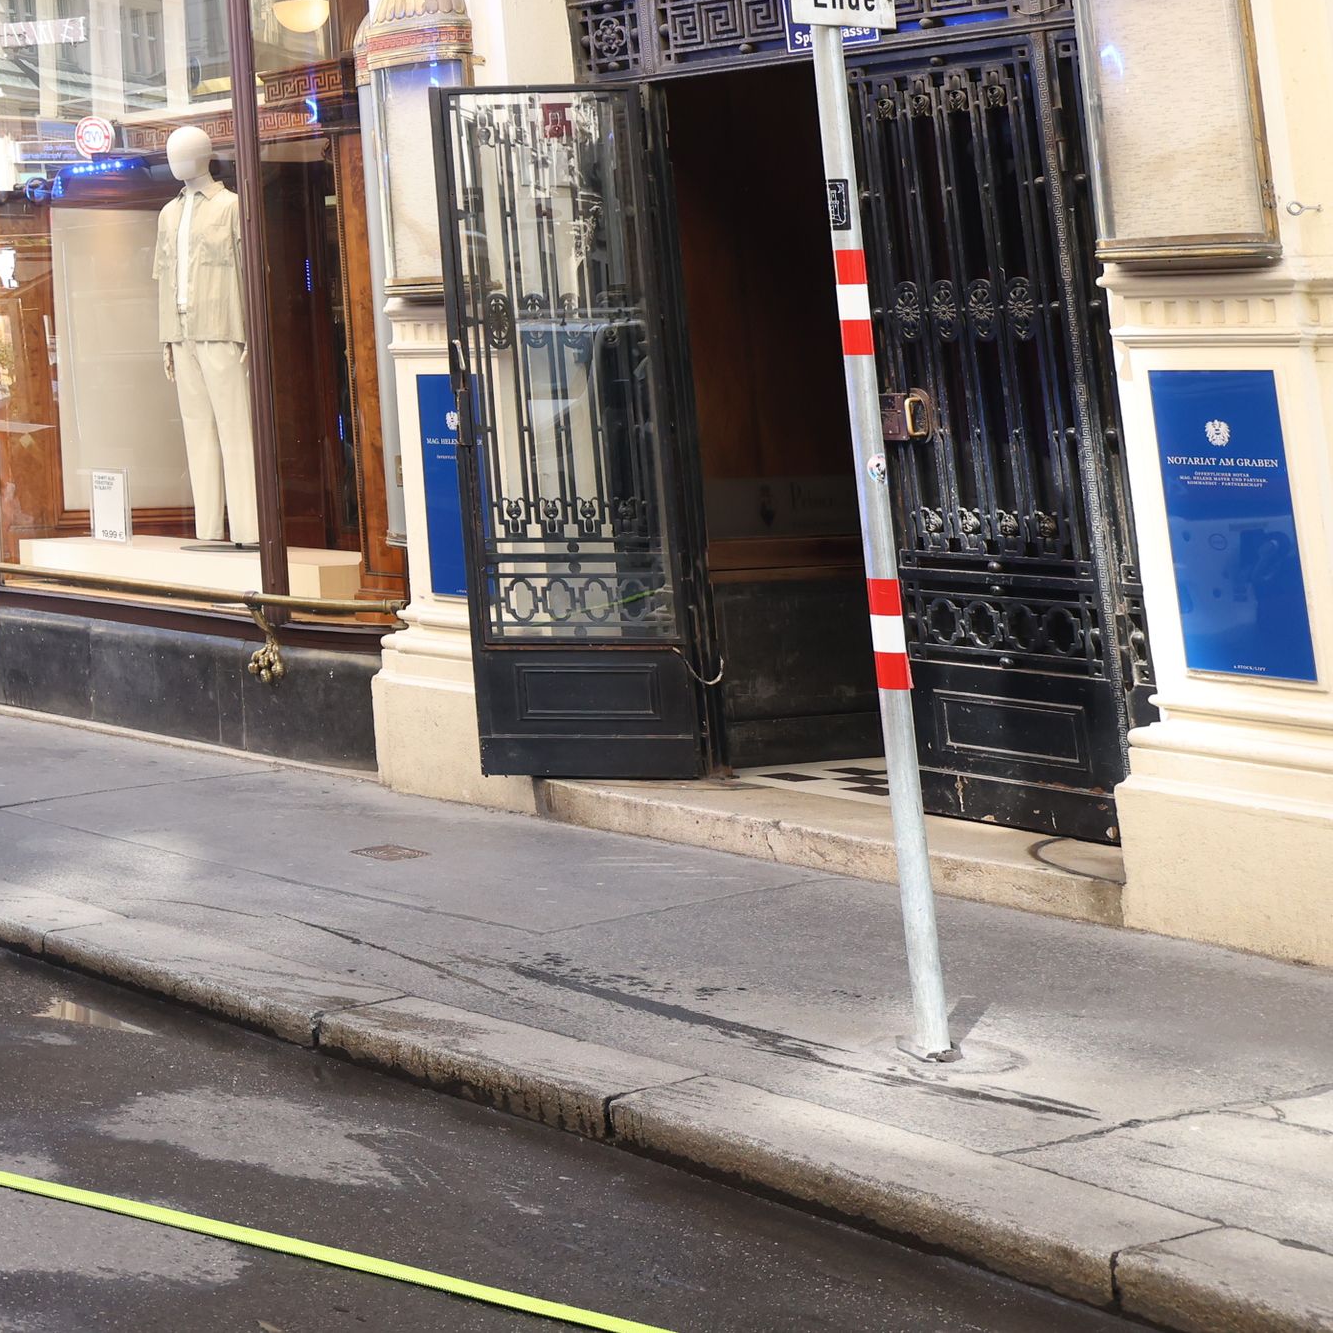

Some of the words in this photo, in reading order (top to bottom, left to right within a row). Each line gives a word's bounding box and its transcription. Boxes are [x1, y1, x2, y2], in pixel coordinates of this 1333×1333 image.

[1166, 456, 1217, 466] NOTARIAT
[1219, 457, 1235, 467] AM
[1236, 458, 1278, 468] GRABEN
